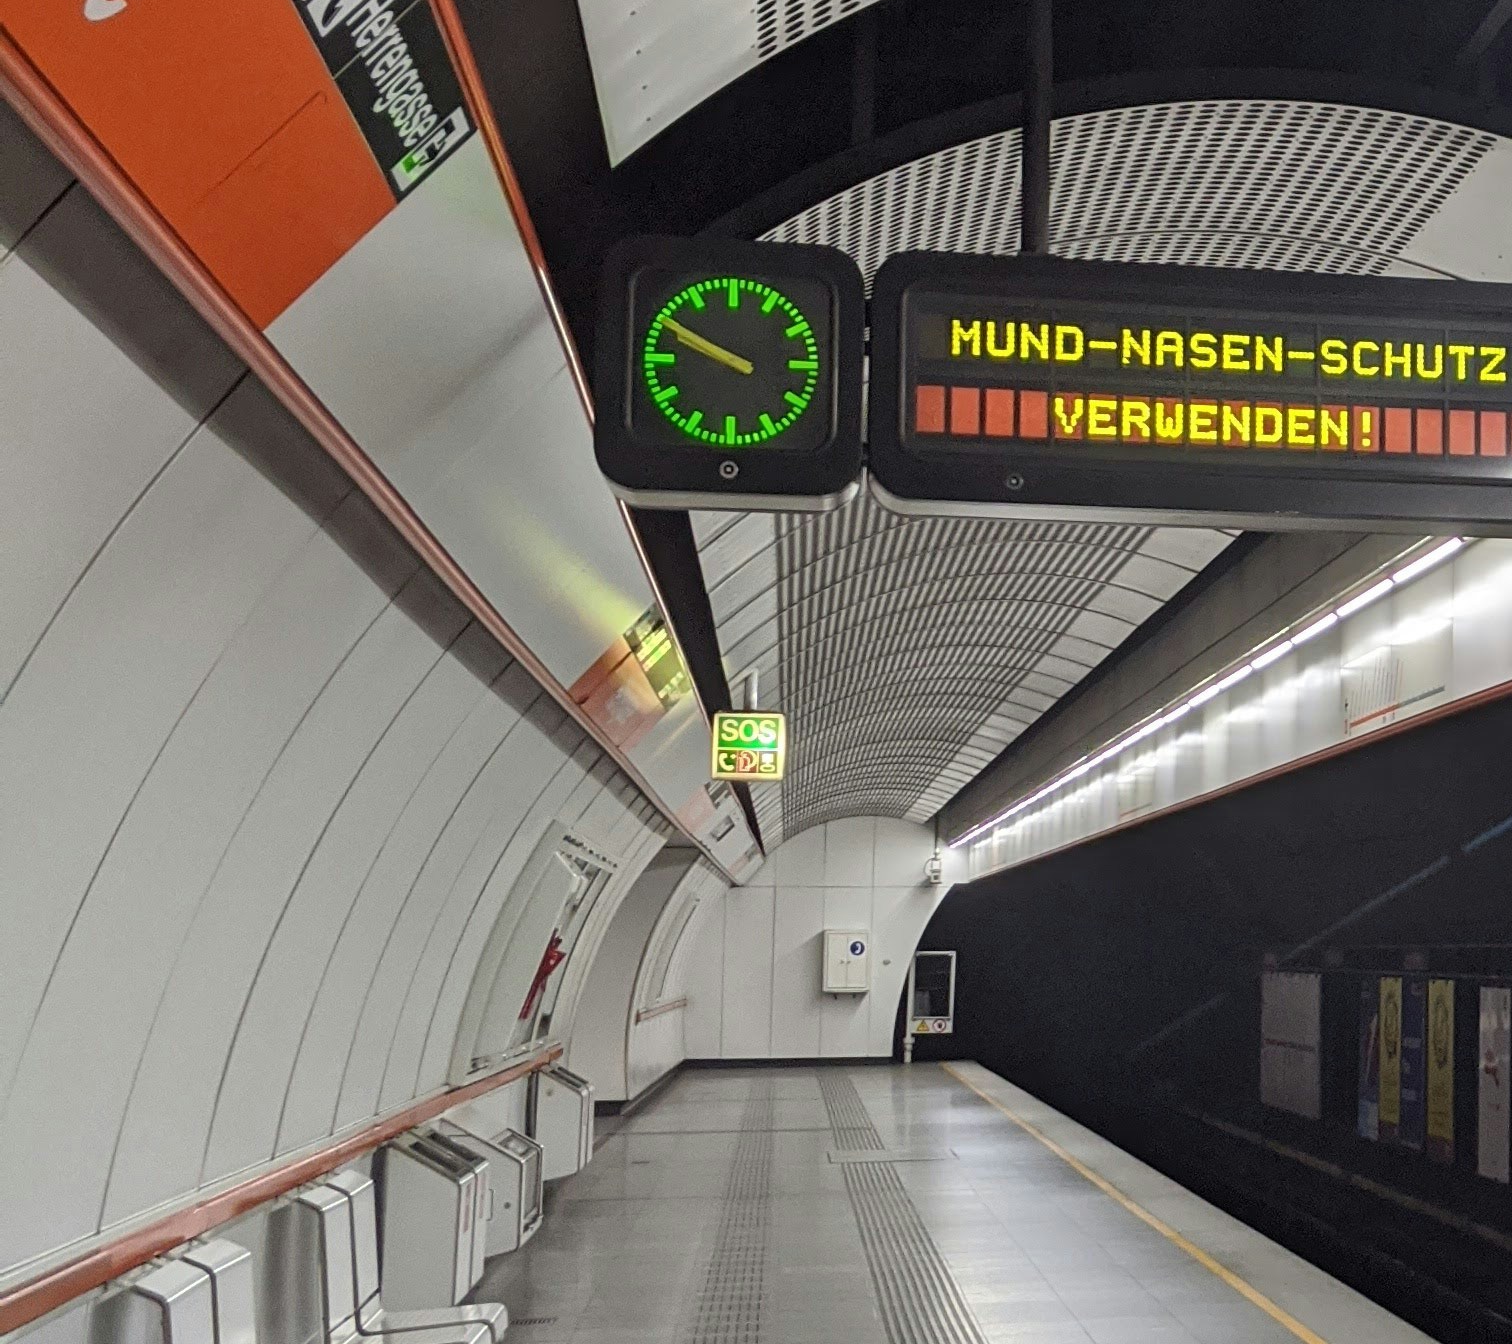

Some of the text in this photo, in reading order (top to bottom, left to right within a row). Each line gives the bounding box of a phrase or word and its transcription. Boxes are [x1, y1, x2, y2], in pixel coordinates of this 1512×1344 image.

[950, 317, 1508, 383] MUND-NASEN-SCHUTZ
[1053, 396, 1372, 449] VERWENDEN!
[720, 718, 777, 744] SOS
